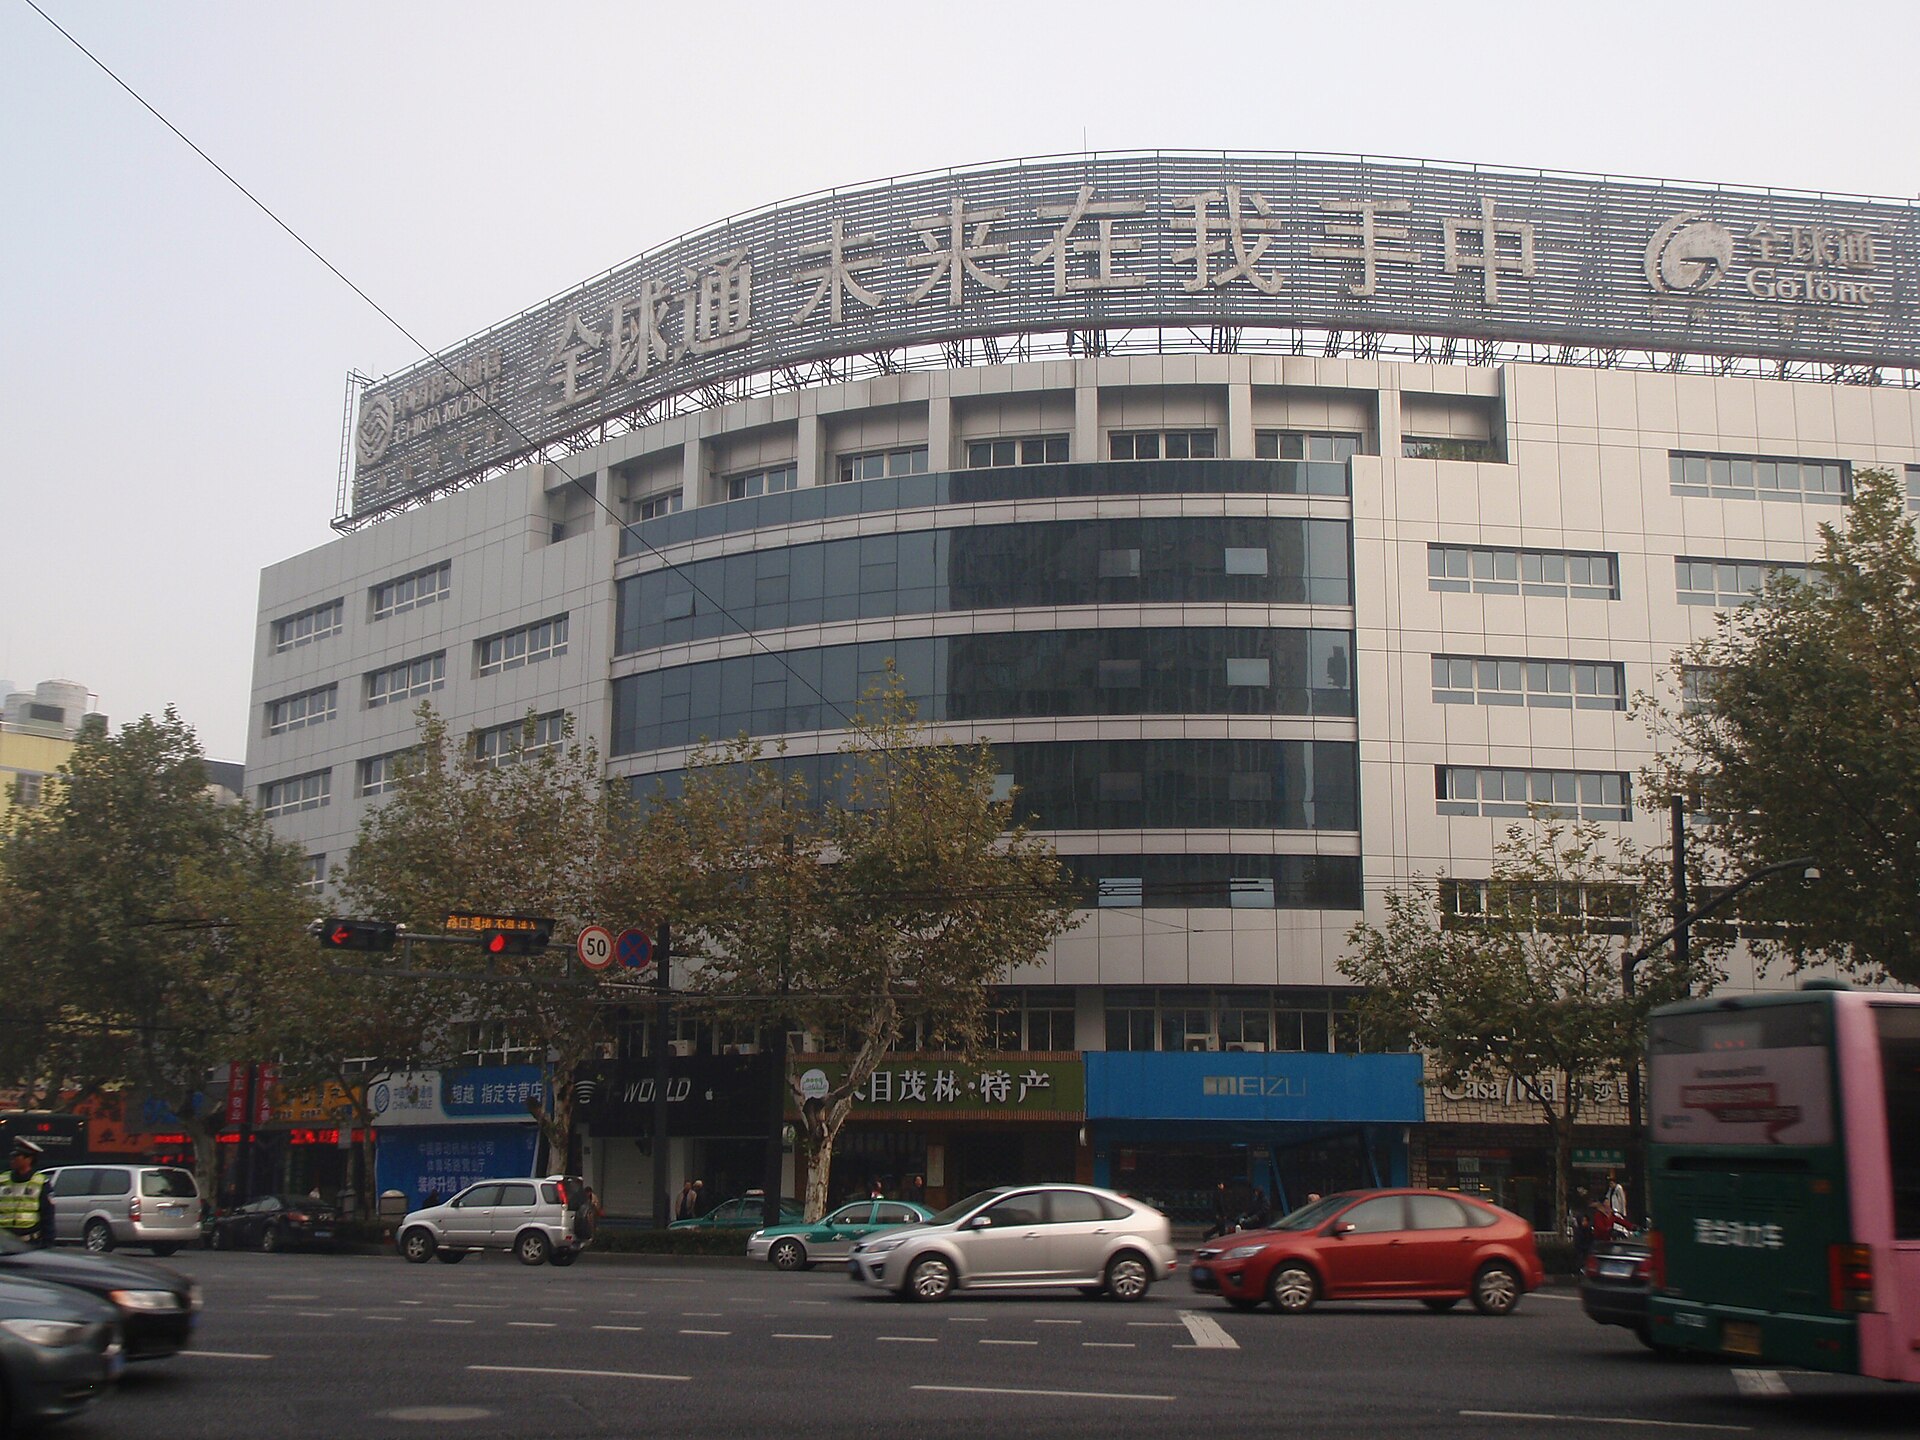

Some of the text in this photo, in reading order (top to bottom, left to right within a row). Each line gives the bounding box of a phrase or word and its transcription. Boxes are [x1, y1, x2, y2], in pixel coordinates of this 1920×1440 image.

[1745, 221, 1877, 269] 全球通
[543, 184, 1535, 415] 全球通 未来在我手中
[1745, 265, 1876, 305] GoTone
[395, 381, 501, 443] CHINA MOBILE
[586, 939, 607, 956] 50
[480, 1080, 543, 1104] 指定专营店
[1504, 1073, 1558, 1106] Mel
